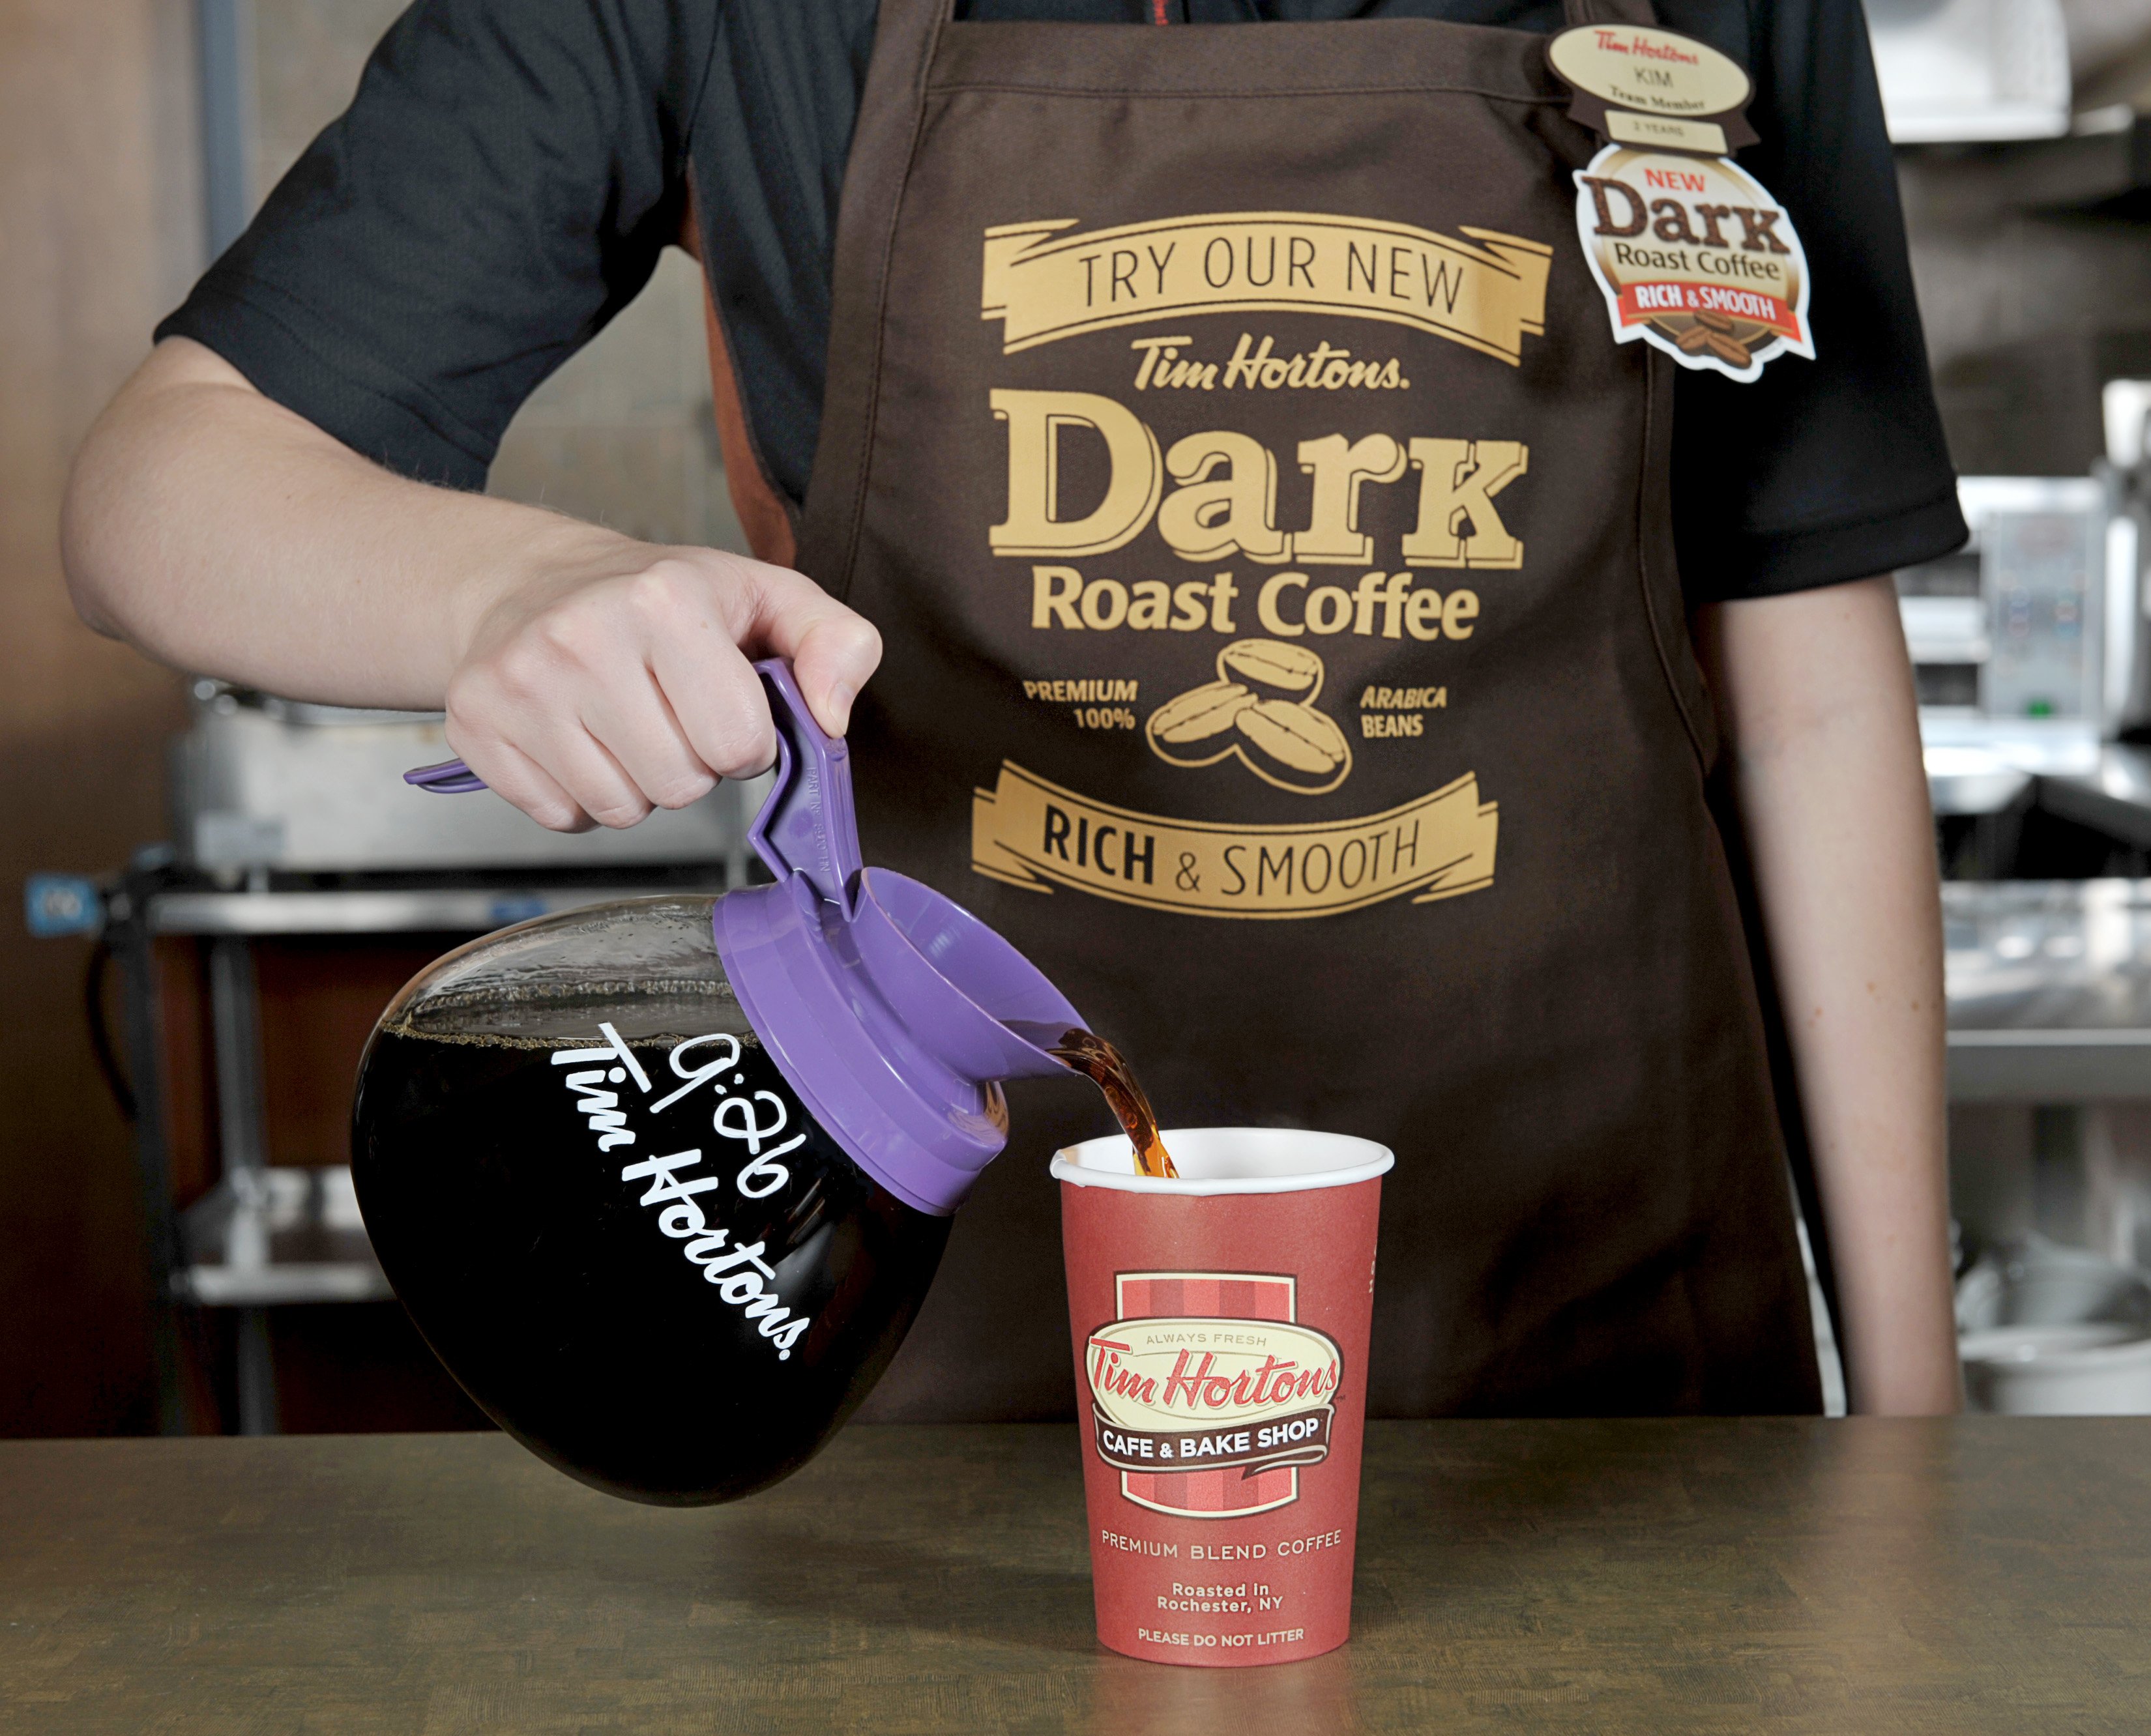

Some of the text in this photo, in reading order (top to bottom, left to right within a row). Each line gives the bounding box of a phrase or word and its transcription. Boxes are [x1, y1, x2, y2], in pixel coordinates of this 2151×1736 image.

[1594, 29, 1700, 66] Tim Hortons
[1634, 67, 1673, 88] KIM
[1609, 83, 1706, 110] Team Member
[1645, 168, 1706, 192] NEW
[1581, 176, 1791, 254] Dark
[1077, 236, 1464, 315] TRY OUR NEW
[1613, 242, 1781, 281] Roast Coffee
[1634, 285, 1777, 321] RICH & SMOOTH
[1130, 335, 1218, 390] Tim
[989, 388, 1529, 570] Dark
[1031, 565, 1480, 641] Roast Coffee
[1023, 680, 1138, 702] PREMIUM
[1360, 686, 1447, 708] ARABICA
[1074, 708, 1136, 730] 100%
[1361, 714, 1424, 738] BEANS
[806, 767, 820, 796] PART
[1043, 803, 1421, 897] RICH & SMOOTH
[551, 1022, 652, 1152] Tim
[1146, 1333, 1267, 1347] ALWAYS FRESH
[1089, 1337, 1155, 1403] Tim
[1162, 1348, 1338, 1408] Hortons
[1103, 1417, 1319, 1458] CAFE & BAKE SHOP
[1102, 1529, 1341, 1560] PREMIUM BLEND COFFEE
[1157, 1596, 1283, 1614] Rochester, NY
[1172, 1582, 1246, 1597] Roasted
[1138, 1628, 1304, 1647] PLEASE DO NOT LITTER
